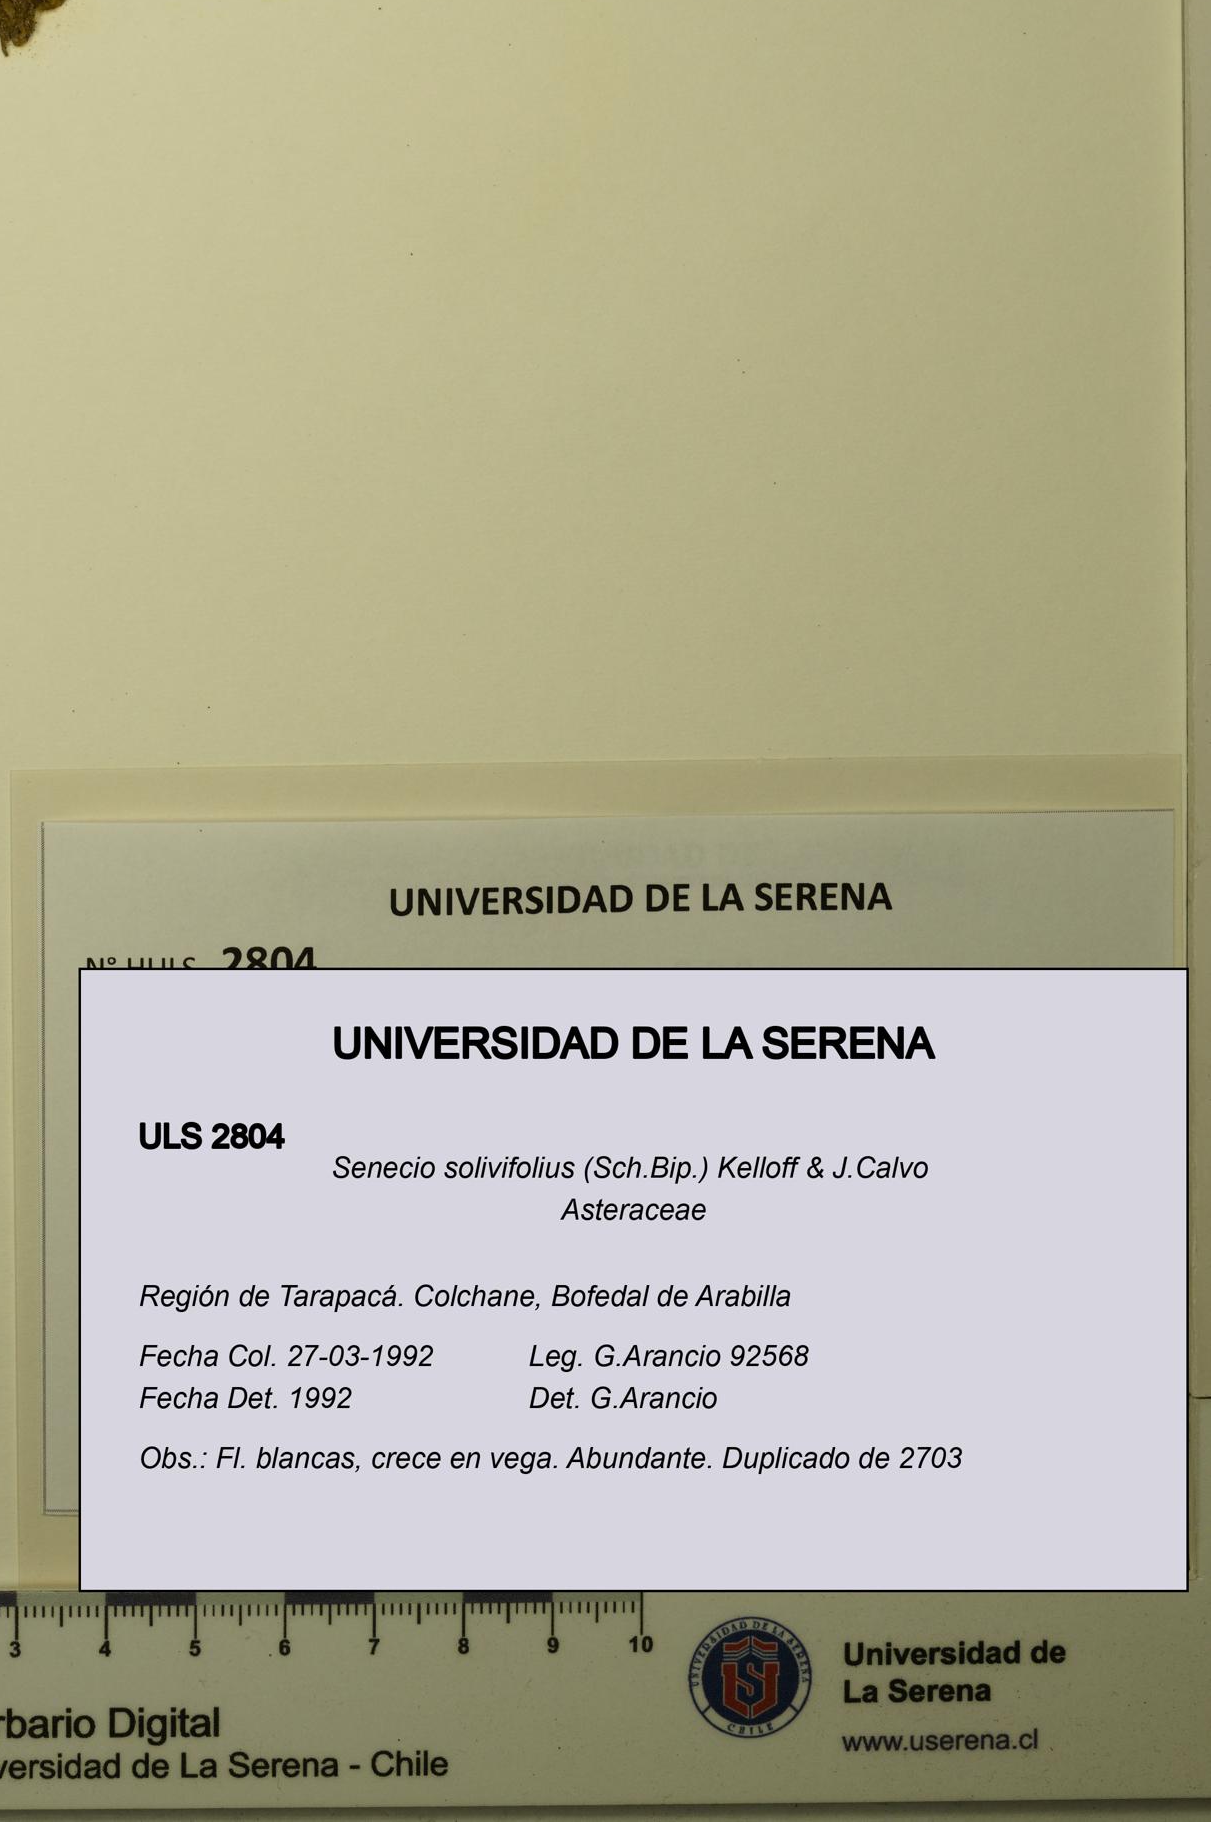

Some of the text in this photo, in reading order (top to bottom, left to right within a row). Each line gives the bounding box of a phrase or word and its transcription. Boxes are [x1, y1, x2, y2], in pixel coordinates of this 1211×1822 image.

[390, 882, 893, 916] UNIVERSIDAD DE LA SERENA
[222, 946, 318, 968] 2804
[9, 1641, 22, 1658] 3
[99, 1641, 112, 1658] 4
[189, 1640, 202, 1657] 5
[279, 1640, 292, 1656] 6
[369, 1639, 380, 1656] 7
[457, 1638, 470, 1655] 8
[547, 1638, 560, 1654] 9
[629, 1636, 654, 1653] 10
[843, 1639, 1067, 1667] Universidad de
[843, 1678, 992, 1704] La Serena
[108, 1707, 220, 1746] Digital
[841, 1728, 1039, 1752] www.userena.cl
[131, 1752, 170, 1780] de
[180, 1752, 218, 1780] La
[228, 1751, 339, 1779] Serena
[370, 1750, 449, 1778] Chile
